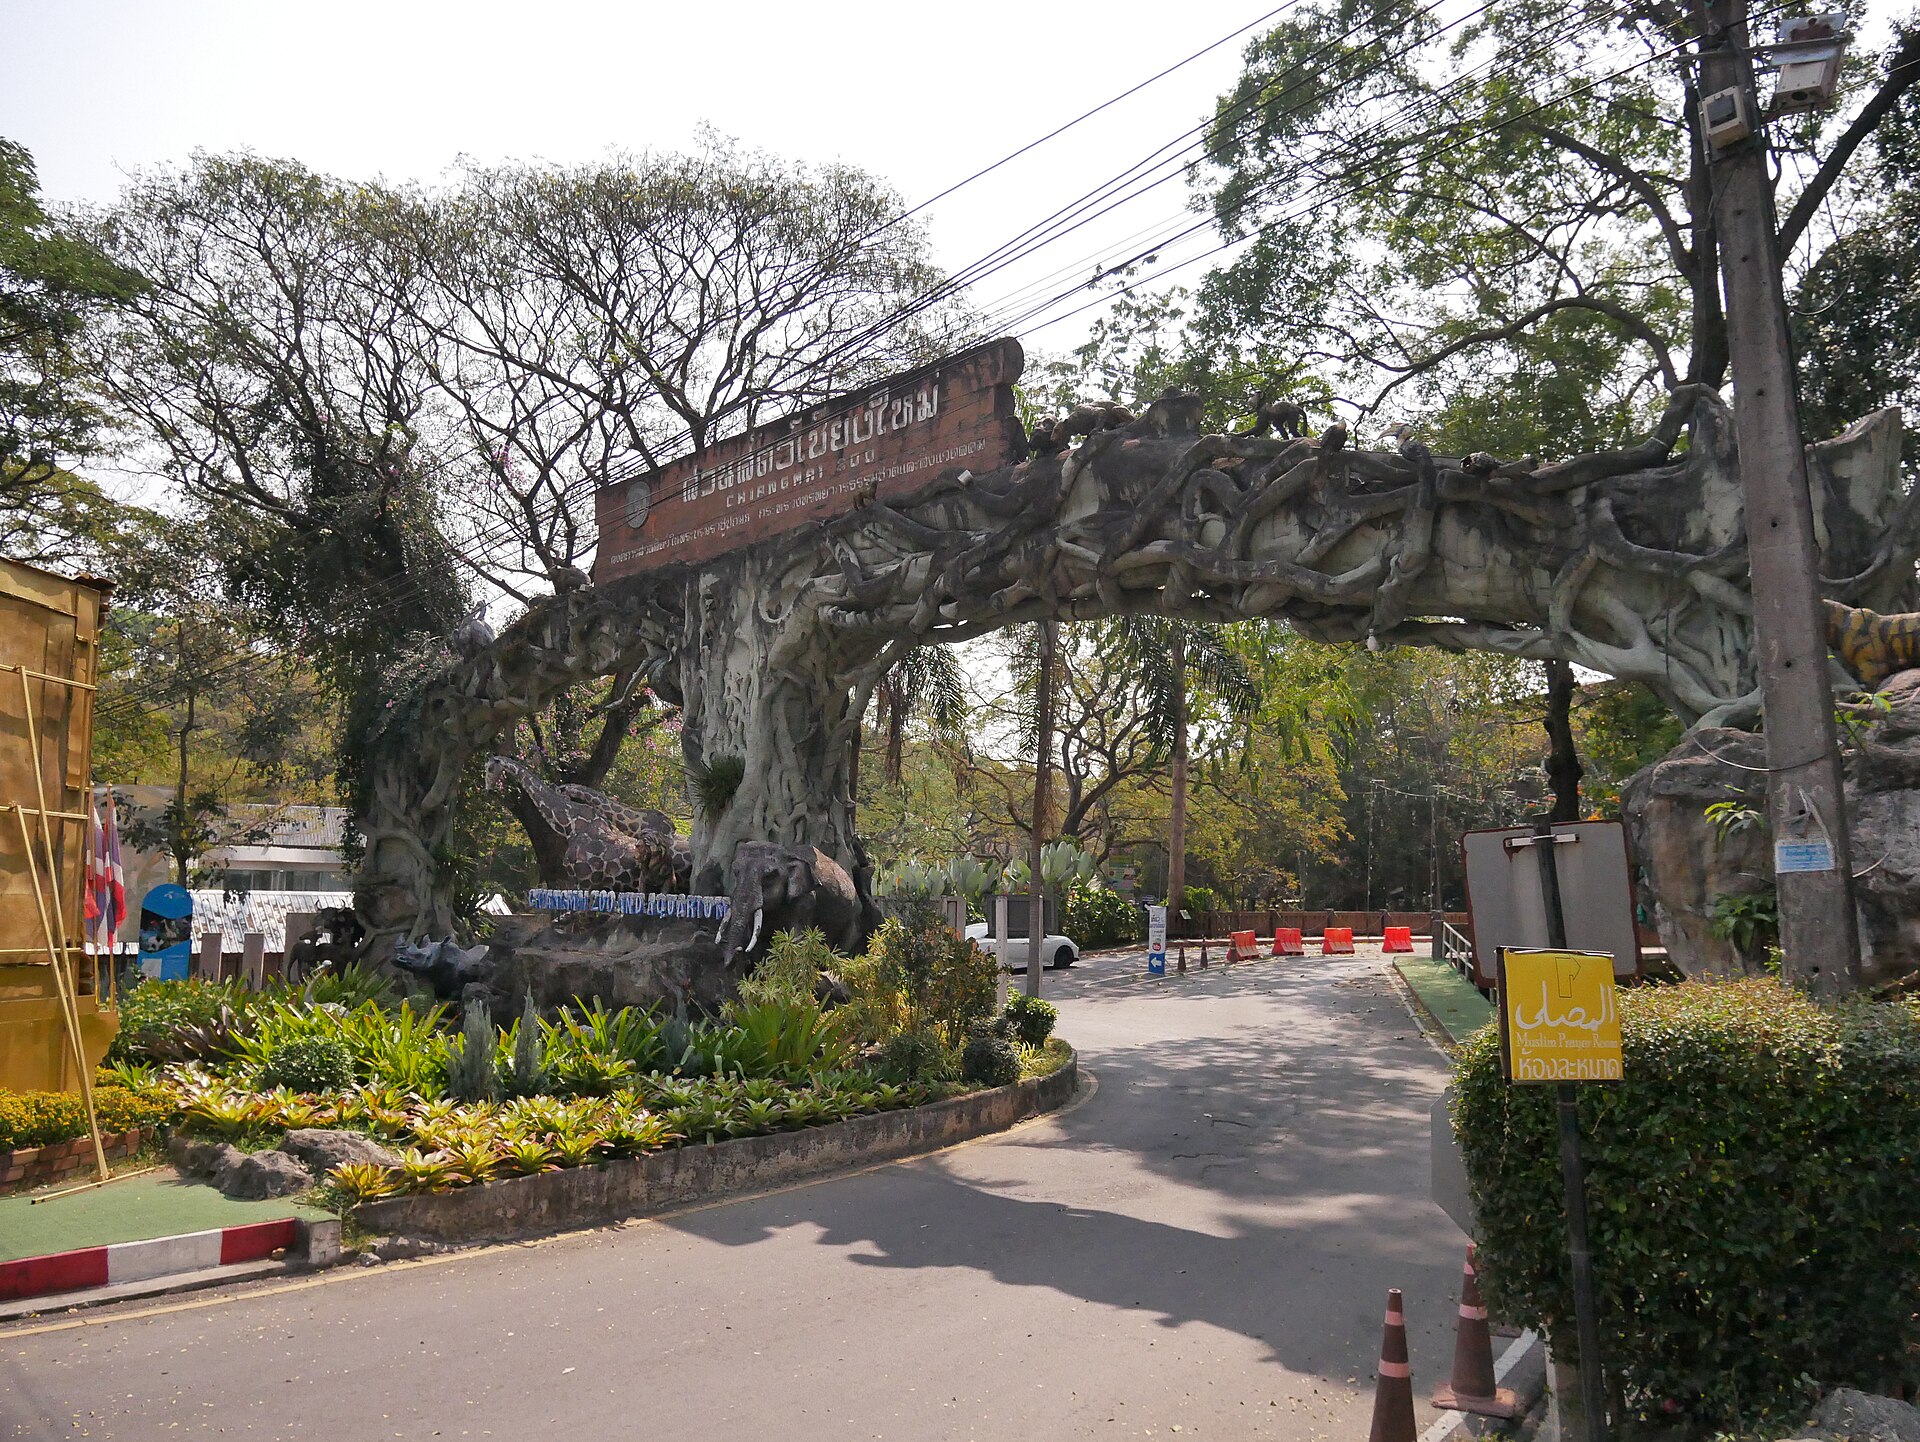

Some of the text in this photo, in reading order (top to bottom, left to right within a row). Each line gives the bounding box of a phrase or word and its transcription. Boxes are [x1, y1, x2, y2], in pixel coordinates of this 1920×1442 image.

[836, 448, 876, 472] ZOO
[589, 889, 616, 912] ZOO
[617, 891, 646, 915] AND
[646, 892, 731, 920] AQUARIUM
[1516, 1031, 1618, 1050] Muslim Prayer Room
[1518, 1048, 1621, 1079] ห้องละหมาด
